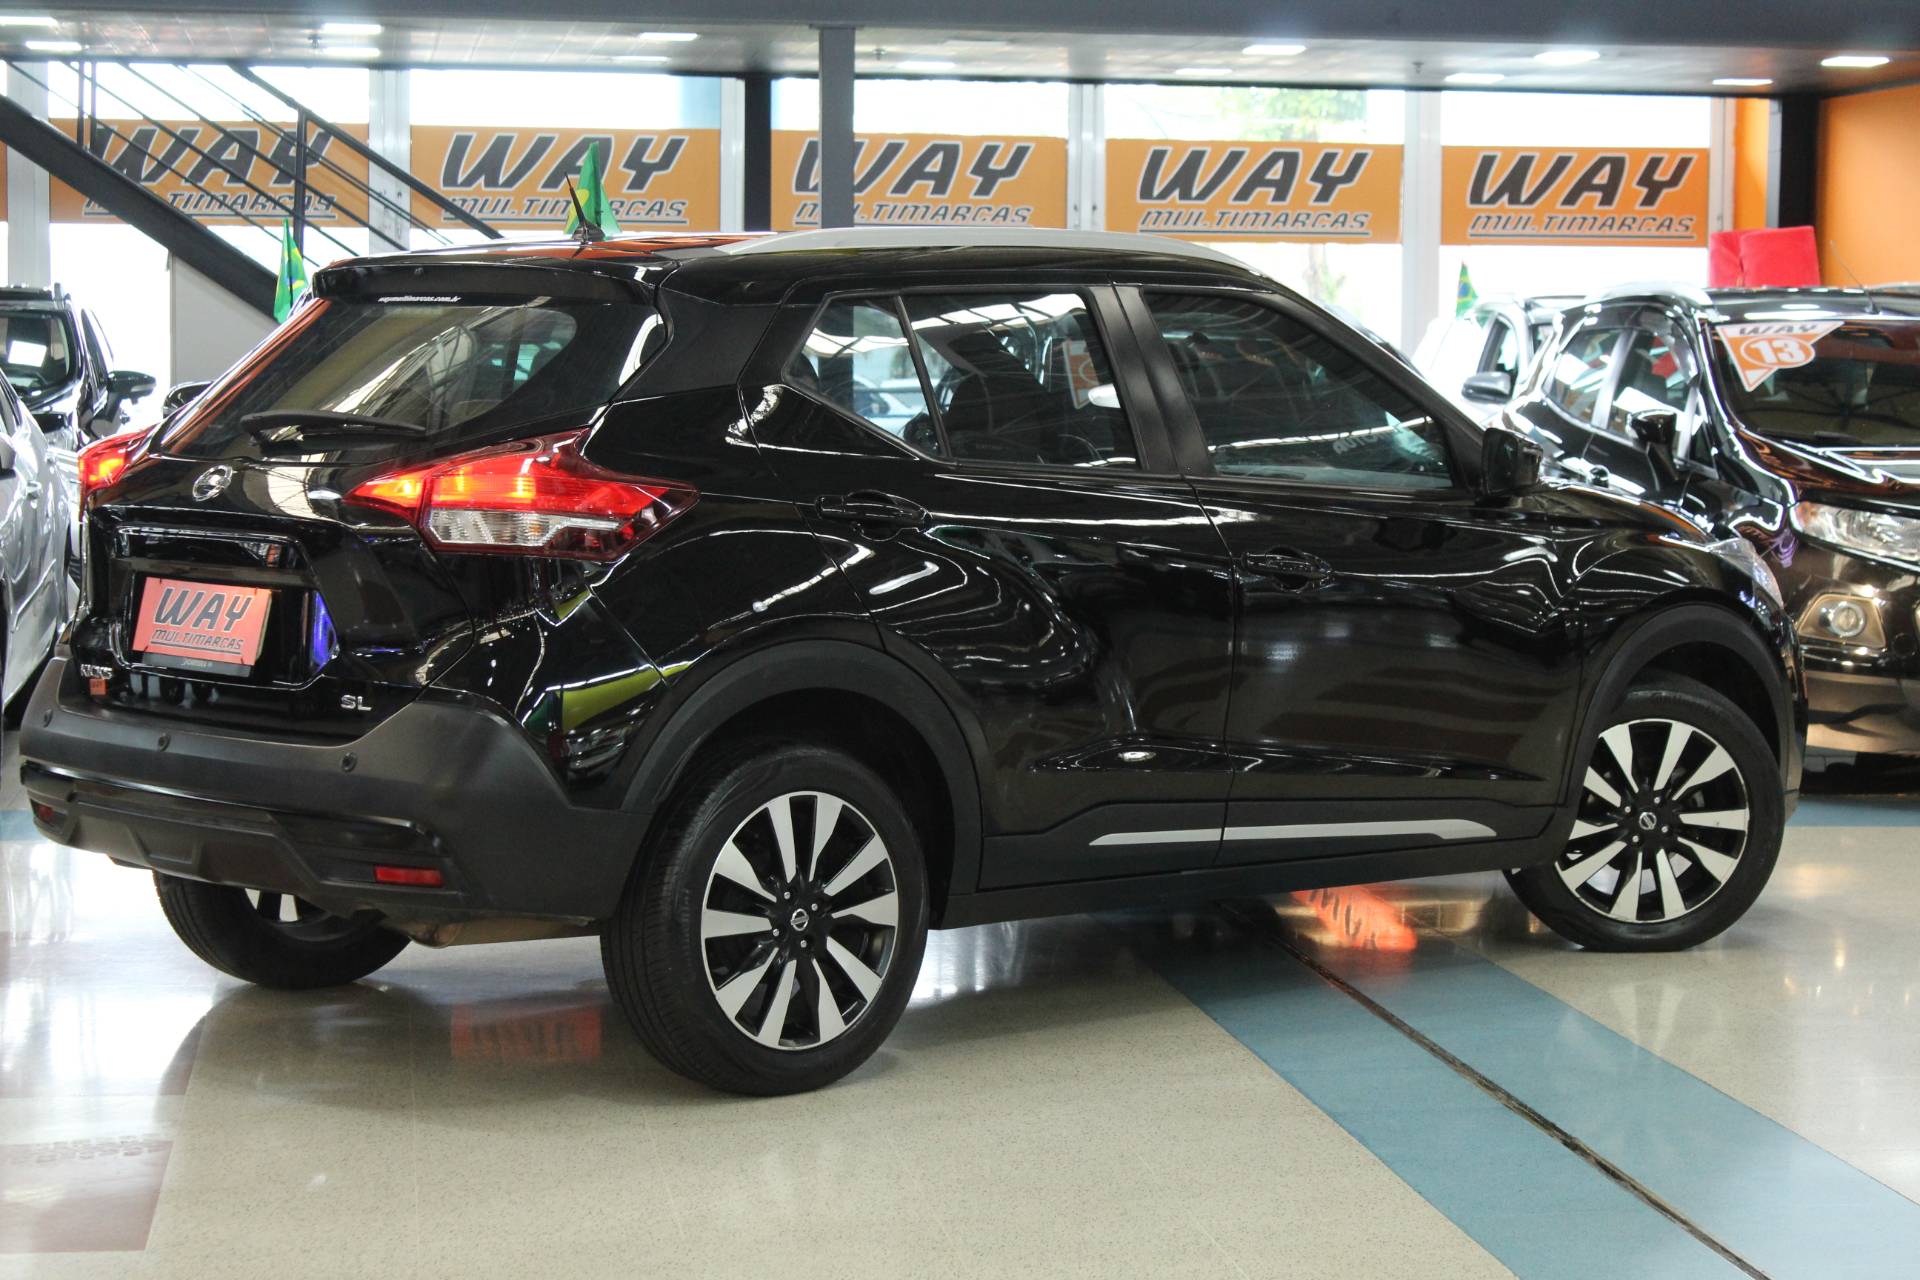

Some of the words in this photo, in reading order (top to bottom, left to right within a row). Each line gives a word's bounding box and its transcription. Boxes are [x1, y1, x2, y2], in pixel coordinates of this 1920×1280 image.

[94, 125, 334, 188] WAY
[441, 132, 689, 193] WAY
[793, 137, 1035, 198] WAY
[1137, 146, 1373, 205] WAY
[1467, 152, 1696, 209] WAY
[446, 197, 688, 217] MULTIMRCAS
[796, 201, 1033, 223] MLTIMARCAS
[1140, 209, 1371, 229] MULTIMARCAS
[1470, 213, 1696, 233] MULTIMARCAS
[1749, 339, 1808, 364] 13
[154, 587, 253, 633] WAY
[152, 629, 244, 650] MULTIMARCAS
[341, 694, 372, 711] SL
